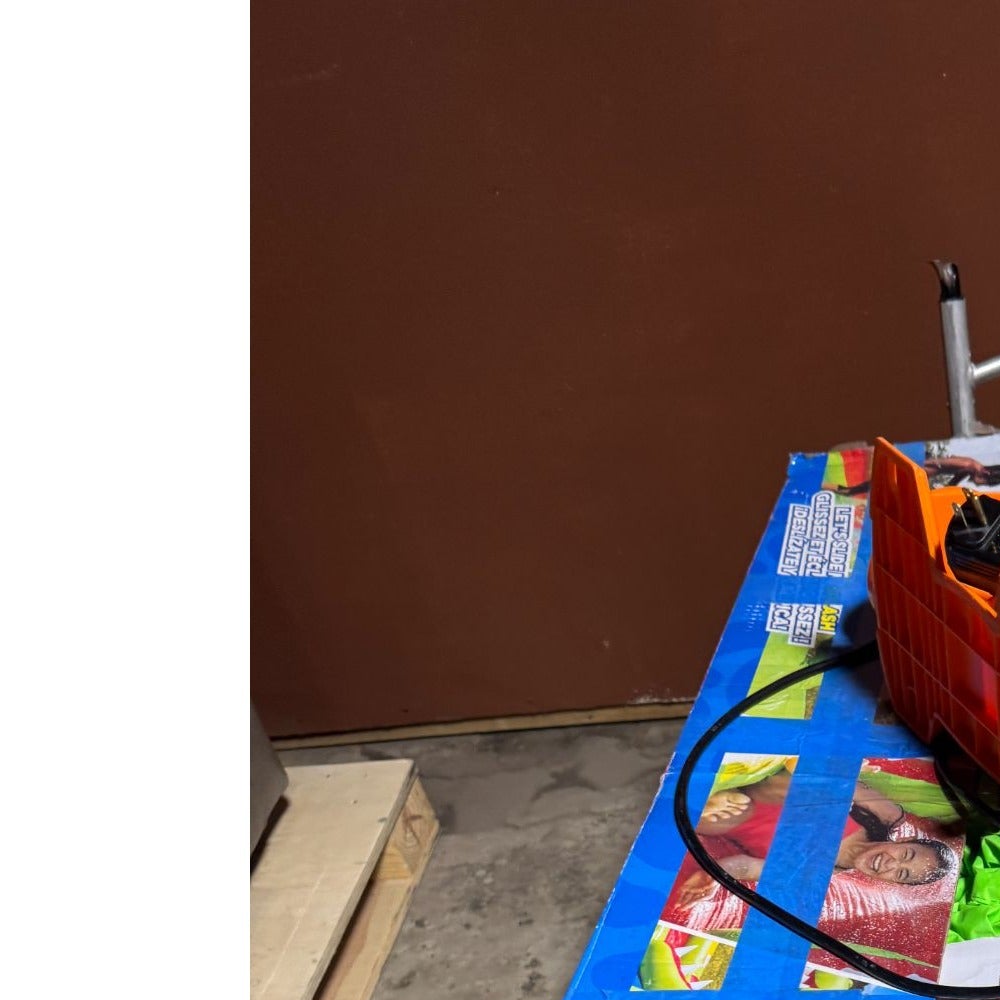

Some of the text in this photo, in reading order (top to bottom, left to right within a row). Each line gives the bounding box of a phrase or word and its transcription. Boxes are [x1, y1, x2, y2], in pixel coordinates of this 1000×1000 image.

[811, 493, 832, 539] GLISSEZ
[833, 507, 851, 539] LET'S
[809, 540, 826, 555] ET
[829, 541, 847, 572] SLIDE
